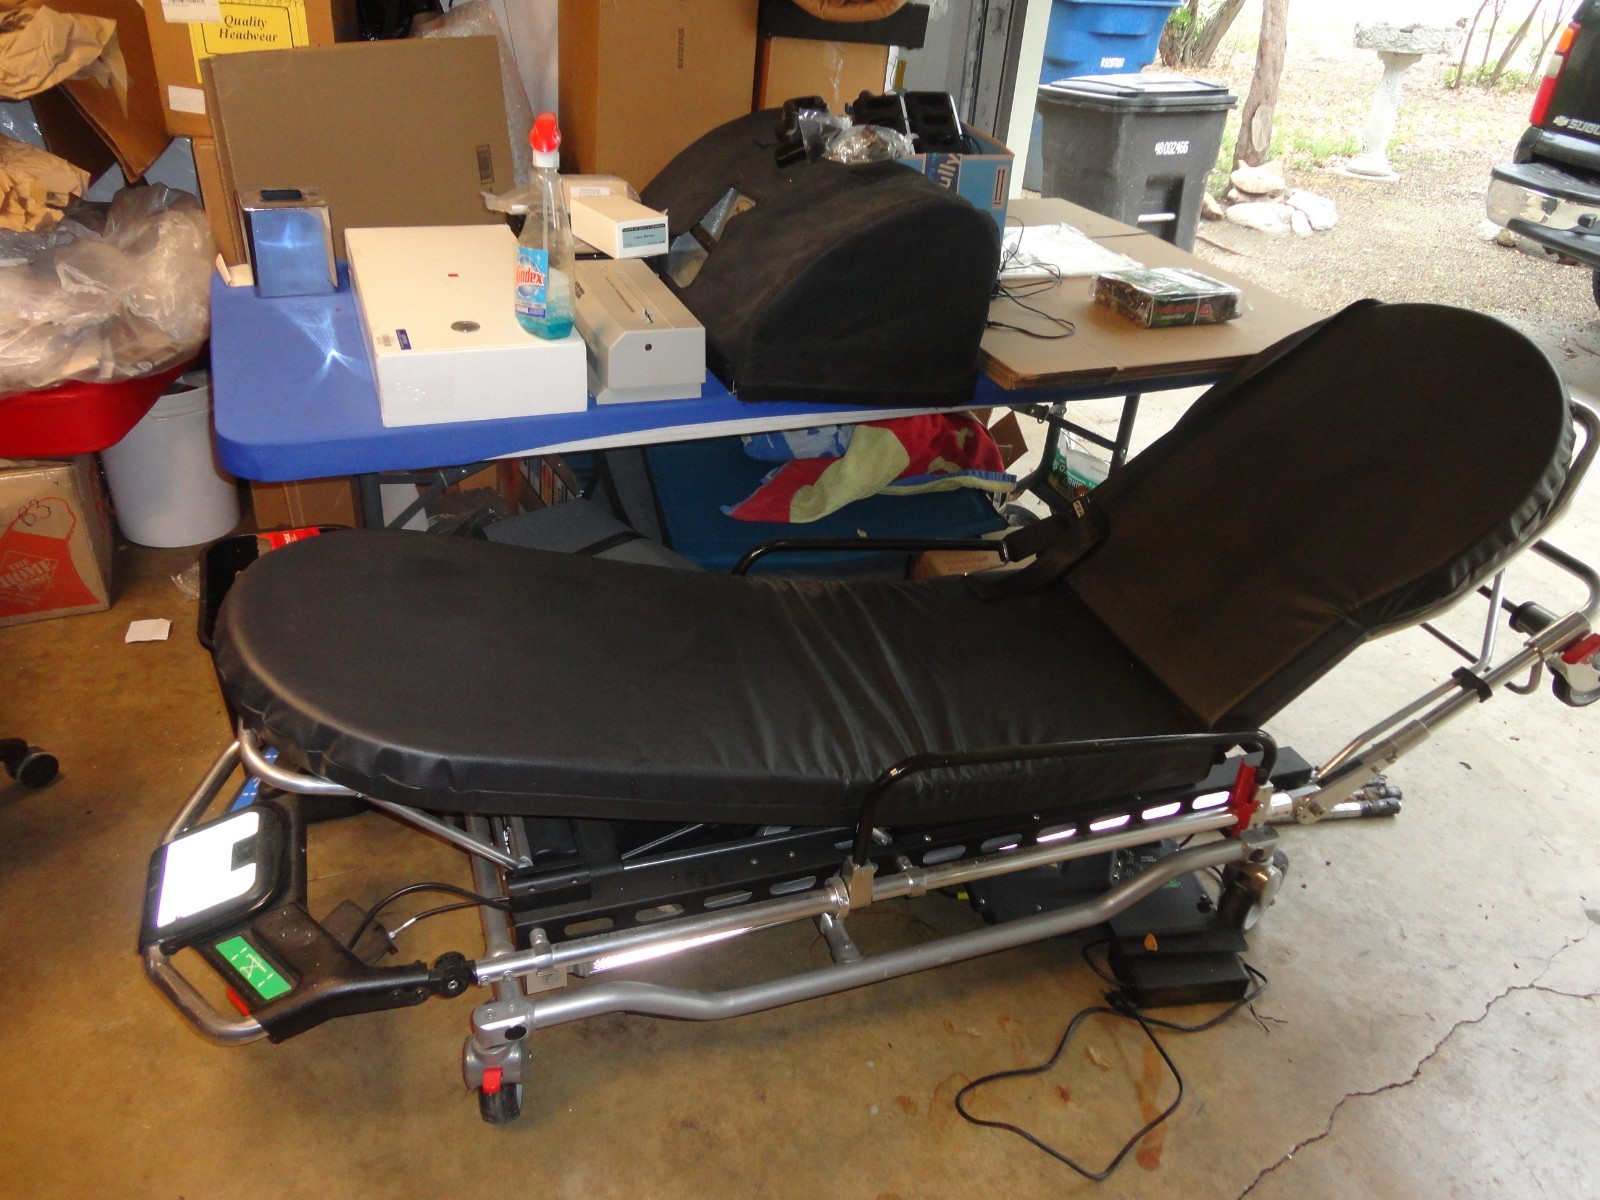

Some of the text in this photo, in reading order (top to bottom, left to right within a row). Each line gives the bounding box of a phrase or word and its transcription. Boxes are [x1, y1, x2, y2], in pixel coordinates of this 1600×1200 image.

[223, 14, 268, 31] Quality
[219, 28, 278, 43] Headwear
[937, 152, 961, 189] ully
